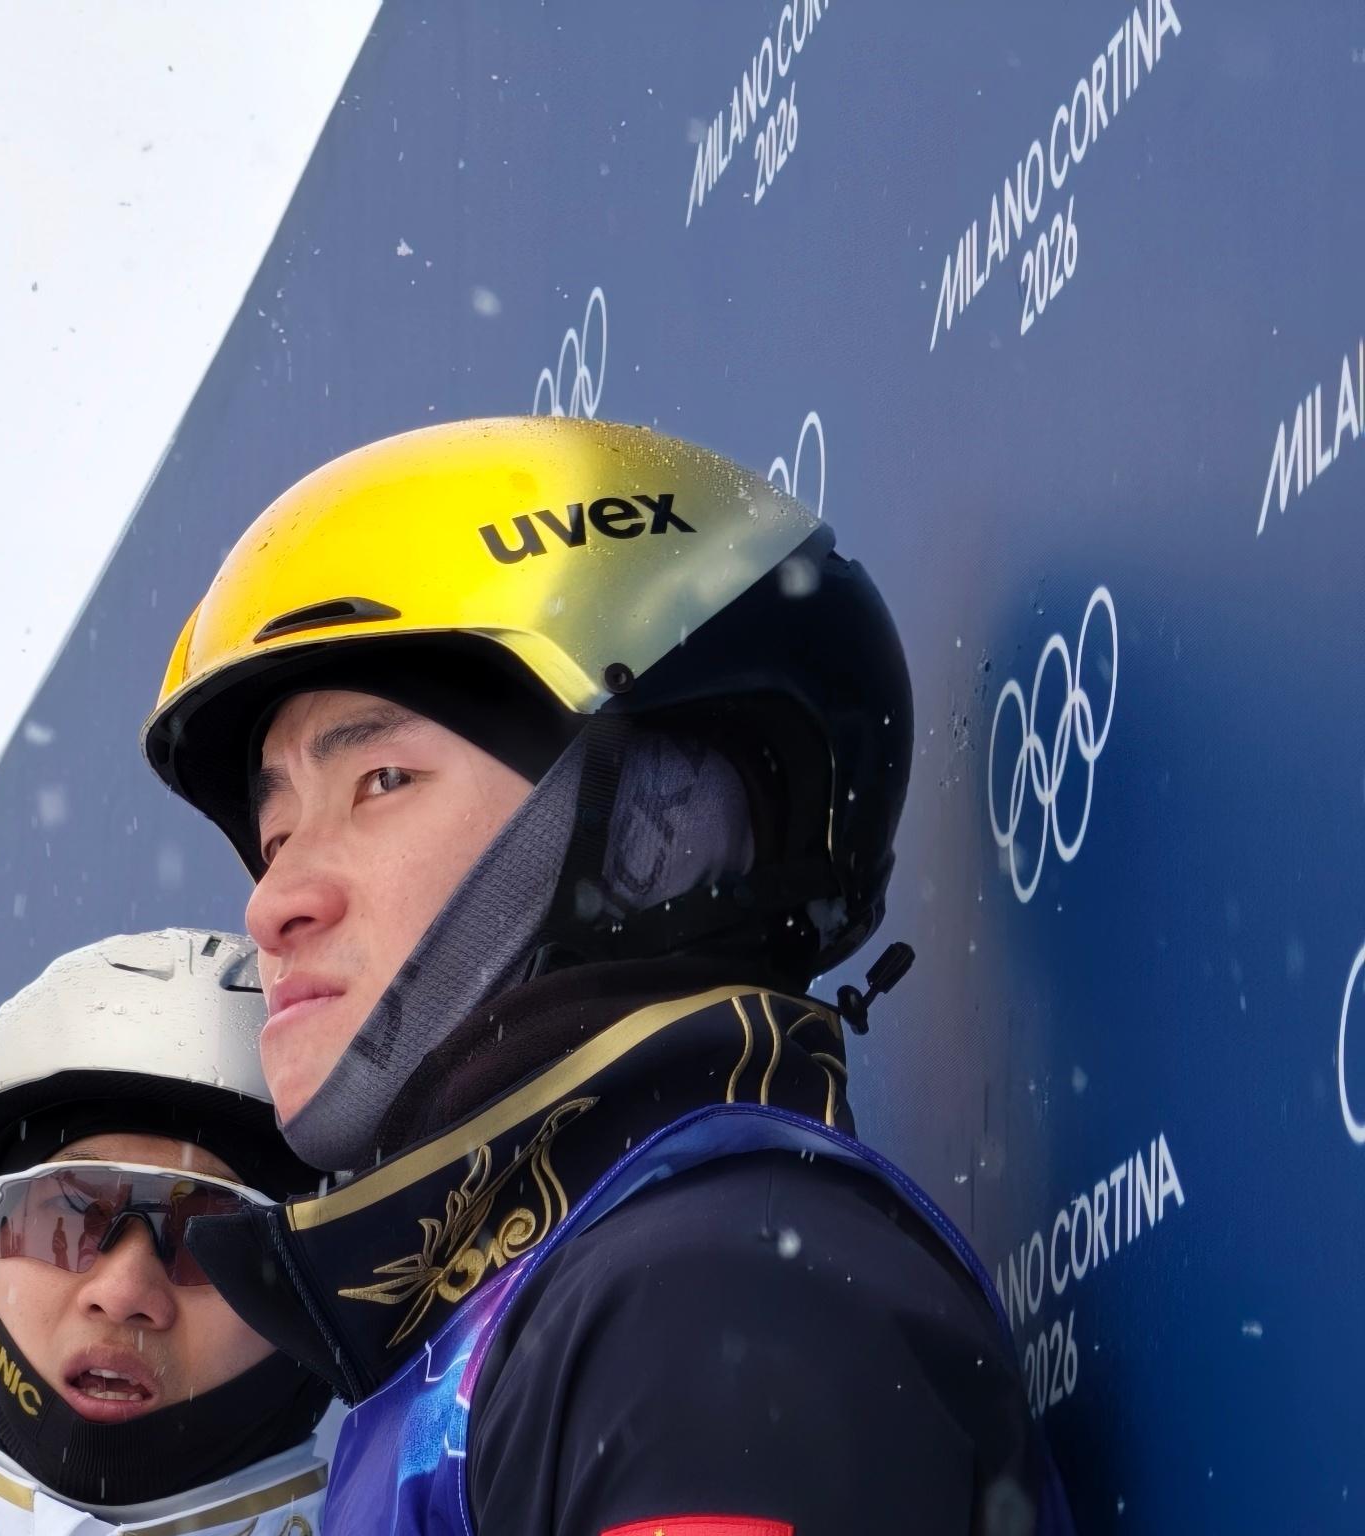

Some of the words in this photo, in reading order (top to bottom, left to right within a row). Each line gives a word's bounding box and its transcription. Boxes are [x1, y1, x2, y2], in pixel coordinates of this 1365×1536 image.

[685, 36, 774, 229] MILANO
[754, 80, 798, 206] 2026
[929, 138, 1044, 353] MILANO
[1049, 0, 1182, 190] CORTINA
[1020, 193, 1078, 337] 2026
[1255, 336, 1365, 539] MILA
[478, 493, 698, 565] uvex
[1050, 1130, 1186, 1296] CORTINA
